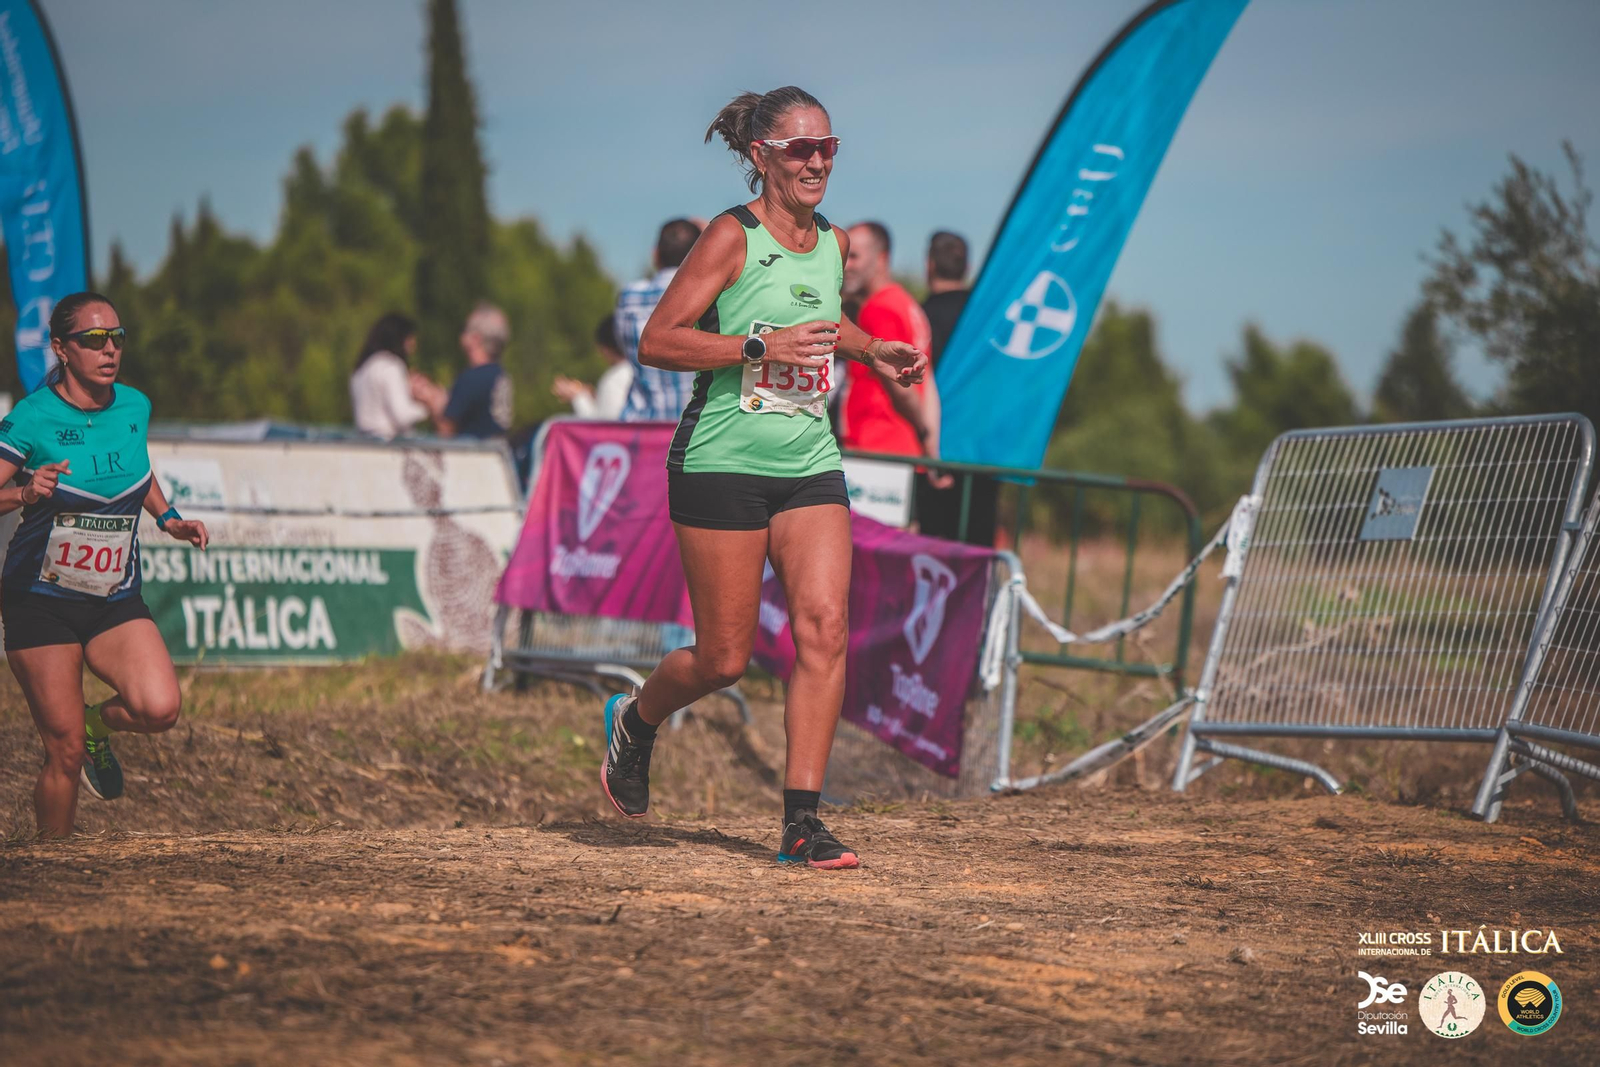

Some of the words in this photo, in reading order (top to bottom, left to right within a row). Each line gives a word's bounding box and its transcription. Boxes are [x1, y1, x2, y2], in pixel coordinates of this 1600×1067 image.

[755, 363, 831, 393] 1358
[80, 517, 118, 530] ITÁLICA
[54, 542, 123, 573] 1201
[189, 549, 390, 585] INTERNACIONAL
[180, 582, 338, 650] ITÁLICA
